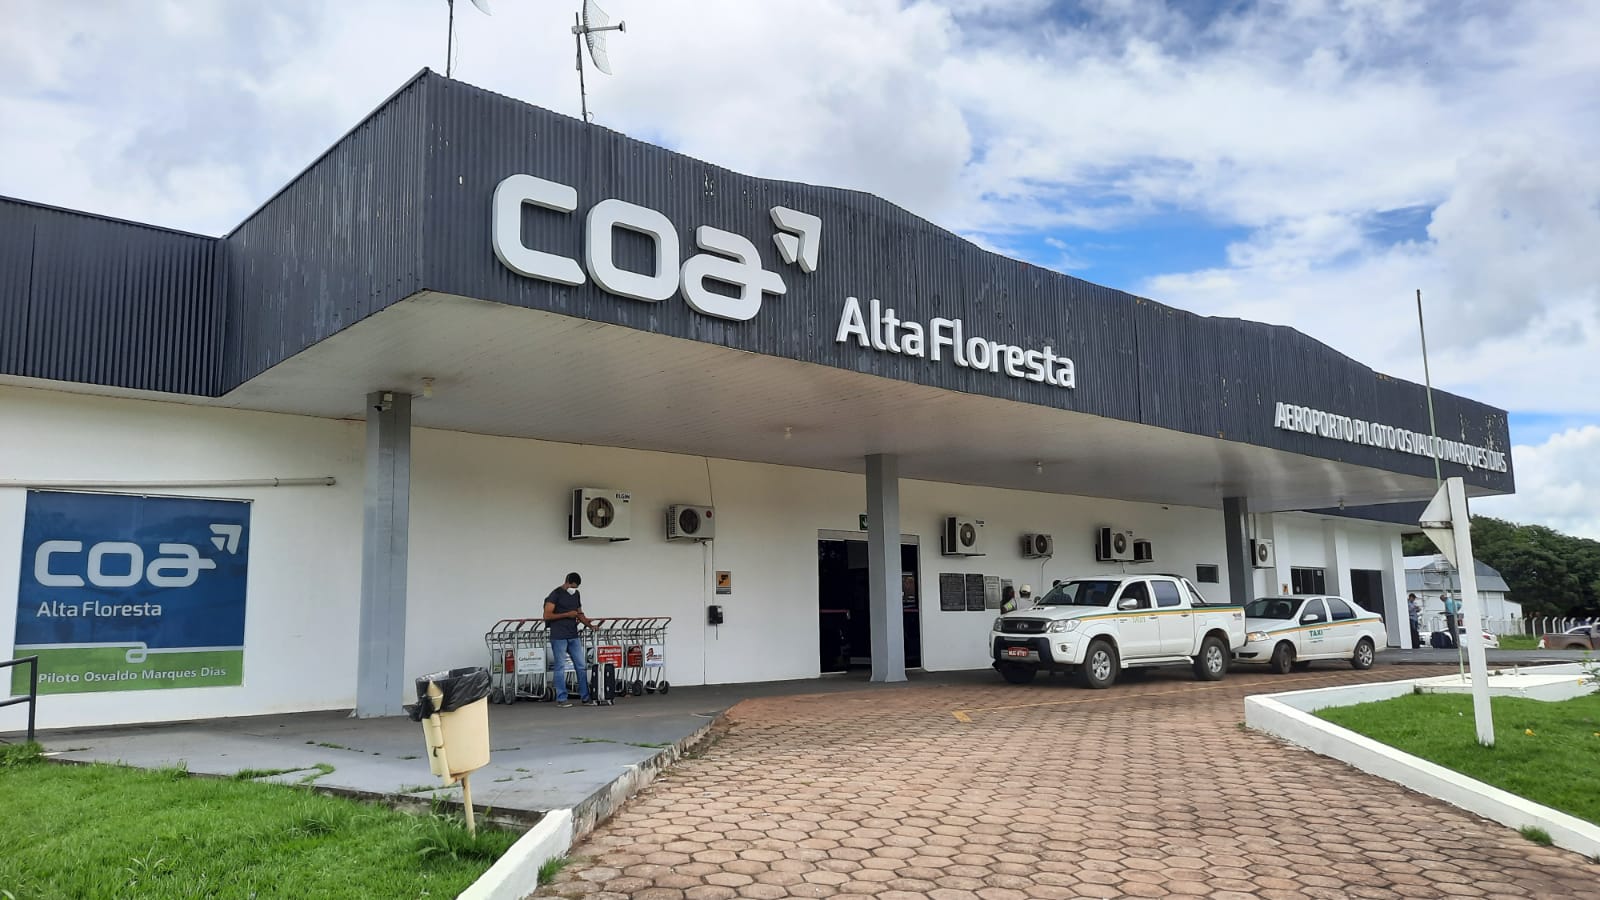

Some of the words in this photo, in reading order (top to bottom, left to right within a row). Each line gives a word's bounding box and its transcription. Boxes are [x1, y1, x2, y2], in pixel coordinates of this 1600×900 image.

[836, 297, 924, 357] Alta
[931, 317, 1076, 389] Floresta
[1274, 402, 1353, 442] AEROPORTO
[1354, 419, 1396, 450] PILOTO
[1444, 440, 1488, 471] MARQUES
[1488, 450, 1507, 473] DIAS
[36, 601, 79, 617] Alta
[82, 601, 162, 617] Floresta
[38, 672, 80, 683] Piloto
[84, 670, 138, 682] Osvaldo
[142, 668, 197, 681] Marques
[200, 666, 227, 677] Dias
